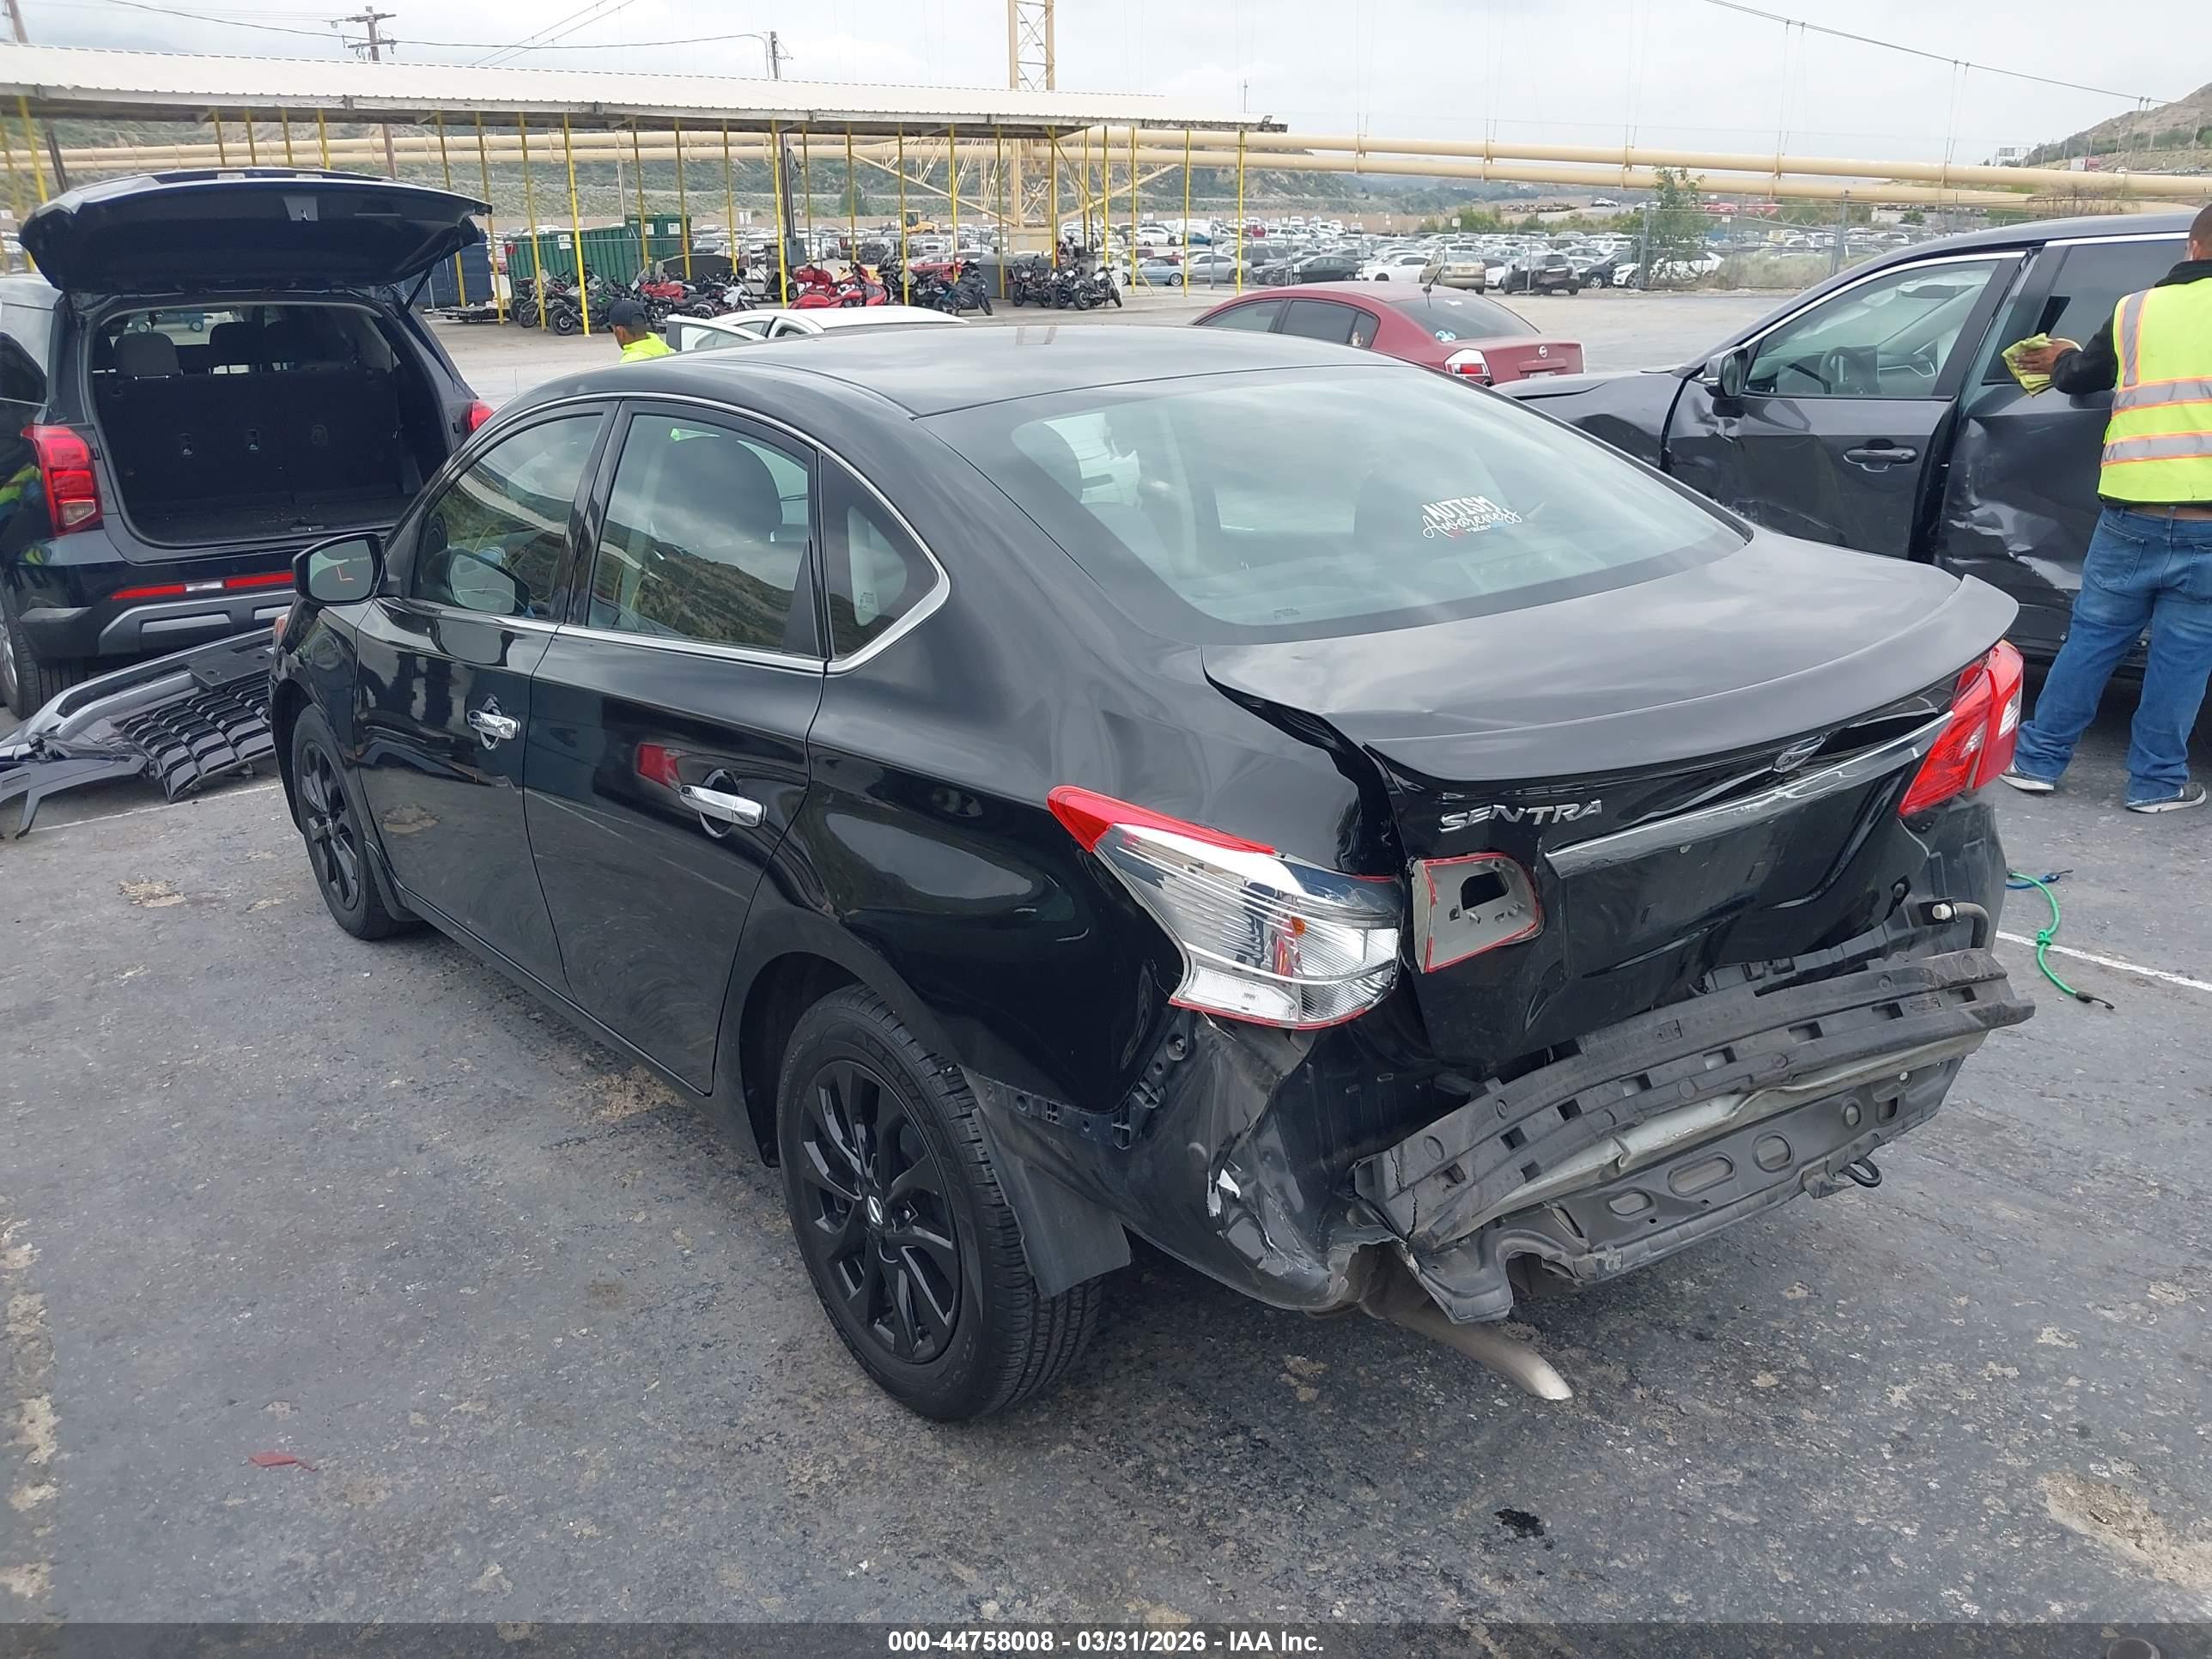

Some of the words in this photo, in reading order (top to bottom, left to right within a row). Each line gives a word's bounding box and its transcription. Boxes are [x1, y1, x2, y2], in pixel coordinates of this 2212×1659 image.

[1421, 495, 1499, 521] AUTISM
[1421, 508, 1522, 539] Awareness
[1438, 799, 1603, 834] SENTRA
